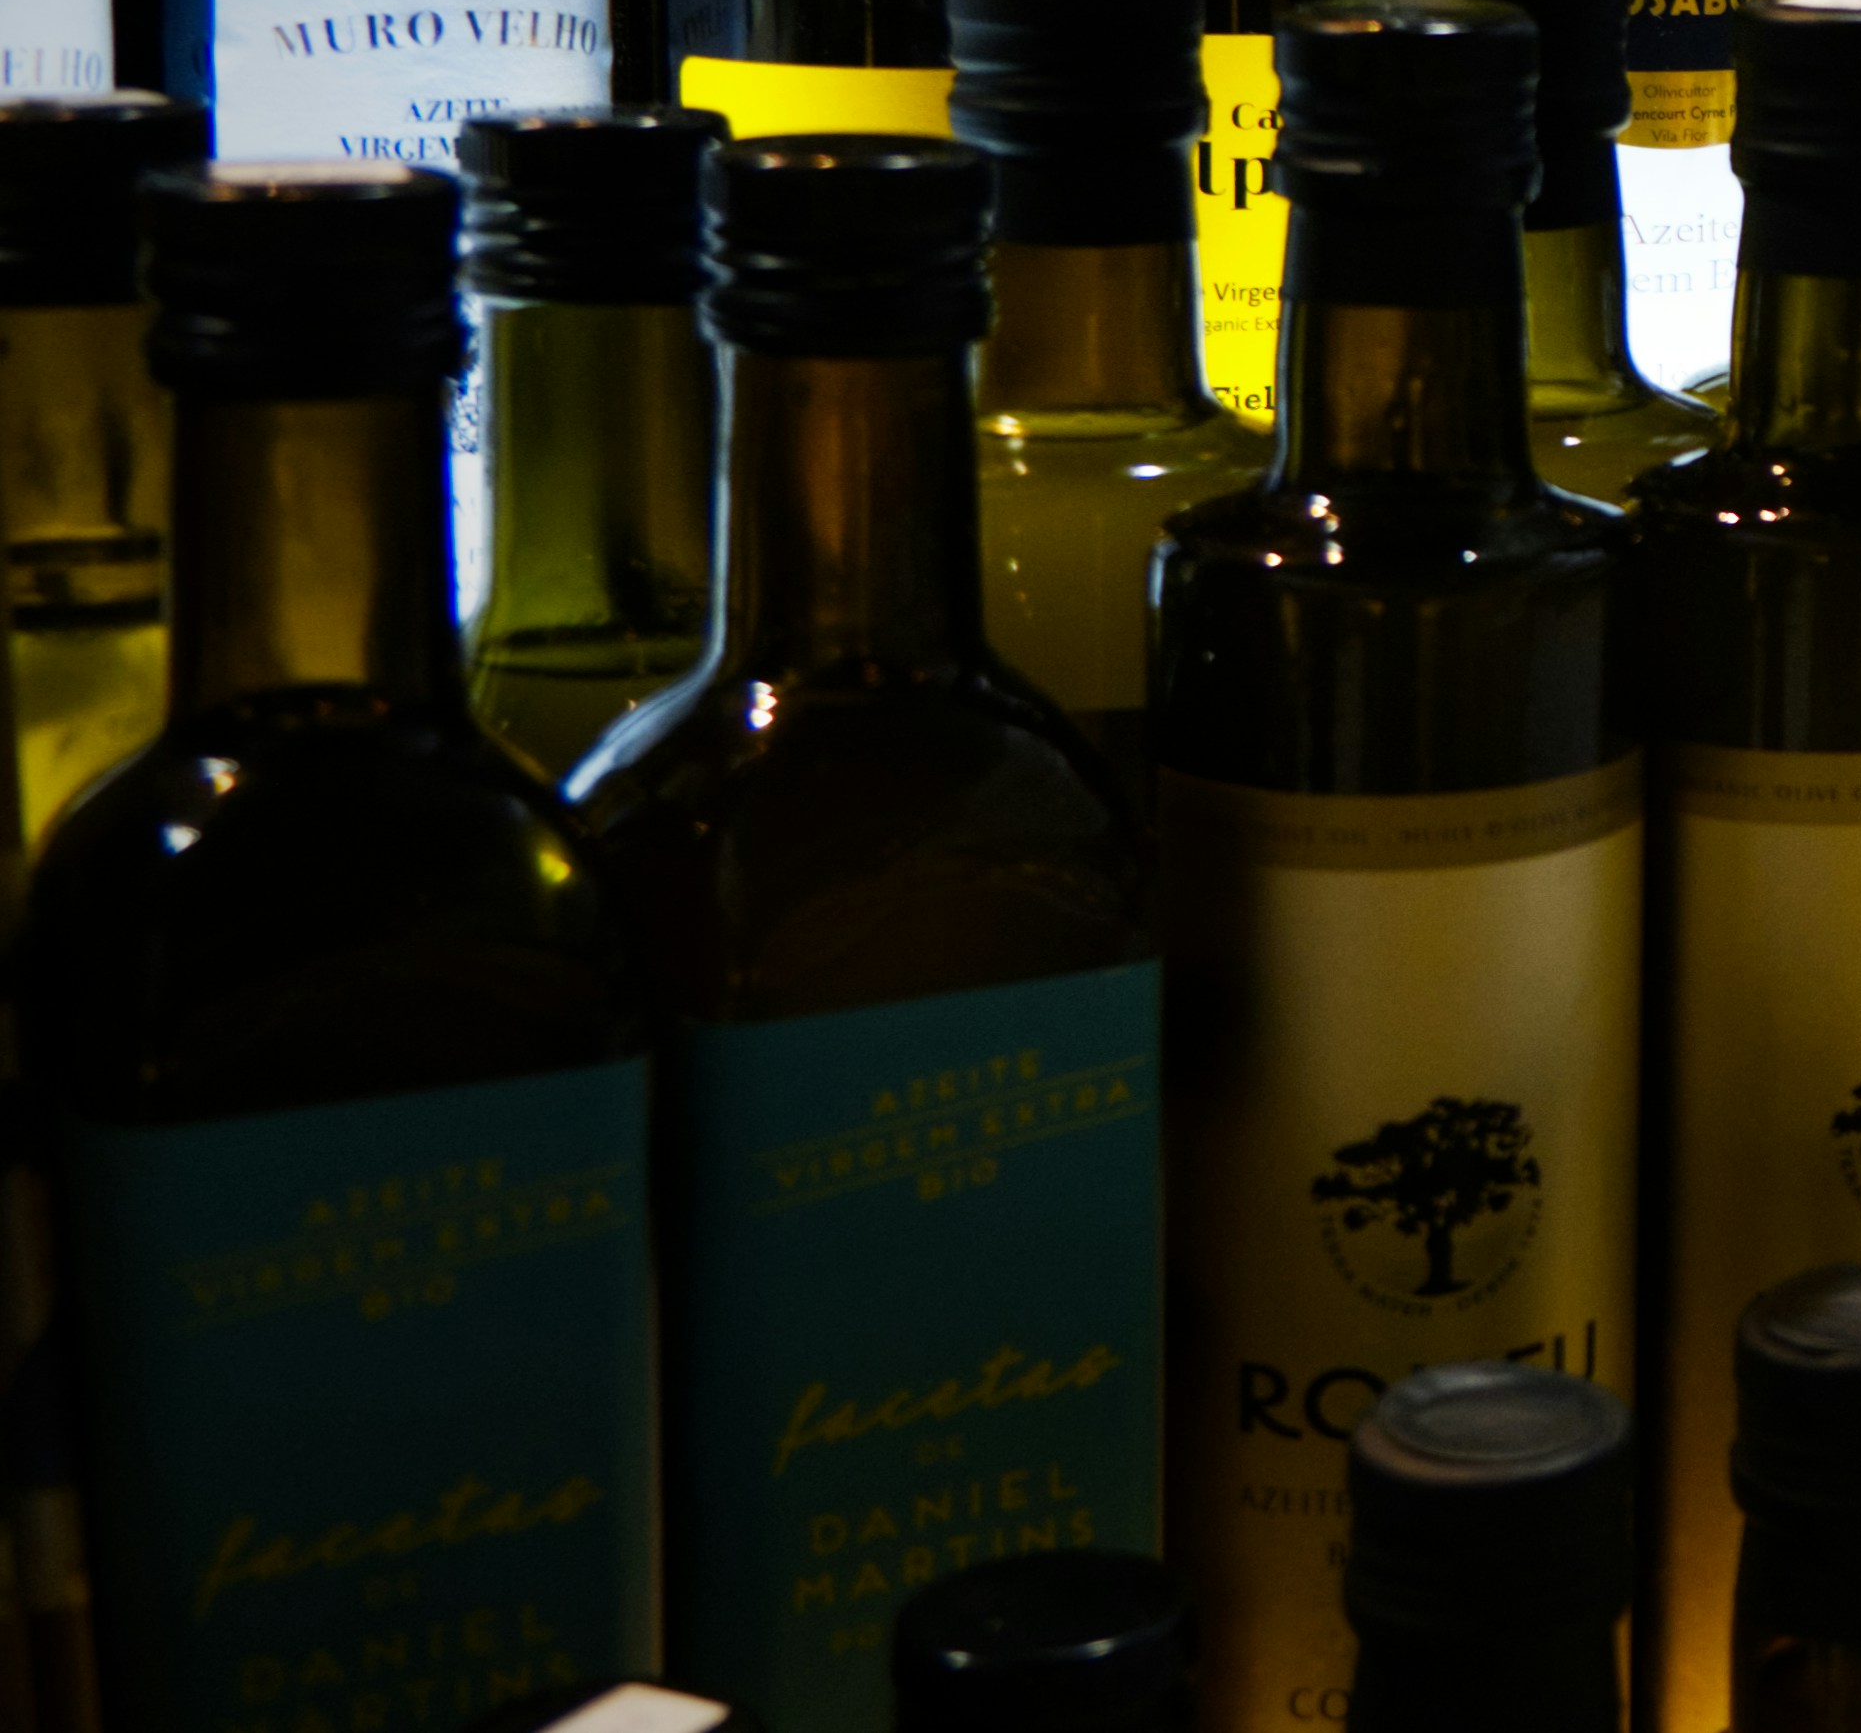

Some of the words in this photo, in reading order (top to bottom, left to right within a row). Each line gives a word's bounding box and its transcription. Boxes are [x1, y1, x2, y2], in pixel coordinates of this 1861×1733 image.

[271, 8, 444, 60] MURO
[464, 8, 598, 56] VELHO
[1643, 84, 1717, 100] Olivicultor
[1231, 102, 1282, 132] Ca
[1690, 107, 1726, 125] Cyrne
[1651, 129, 1678, 144] Vila
[1682, 129, 1710, 144] Flor
[1623, 213, 1738, 245] Azeite
[1213, 282, 1281, 308] Virge
[1204, 317, 1248, 338] ganic
[1212, 385, 1275, 410] Fiel
[808, 1466, 1080, 1557] DANIEL
